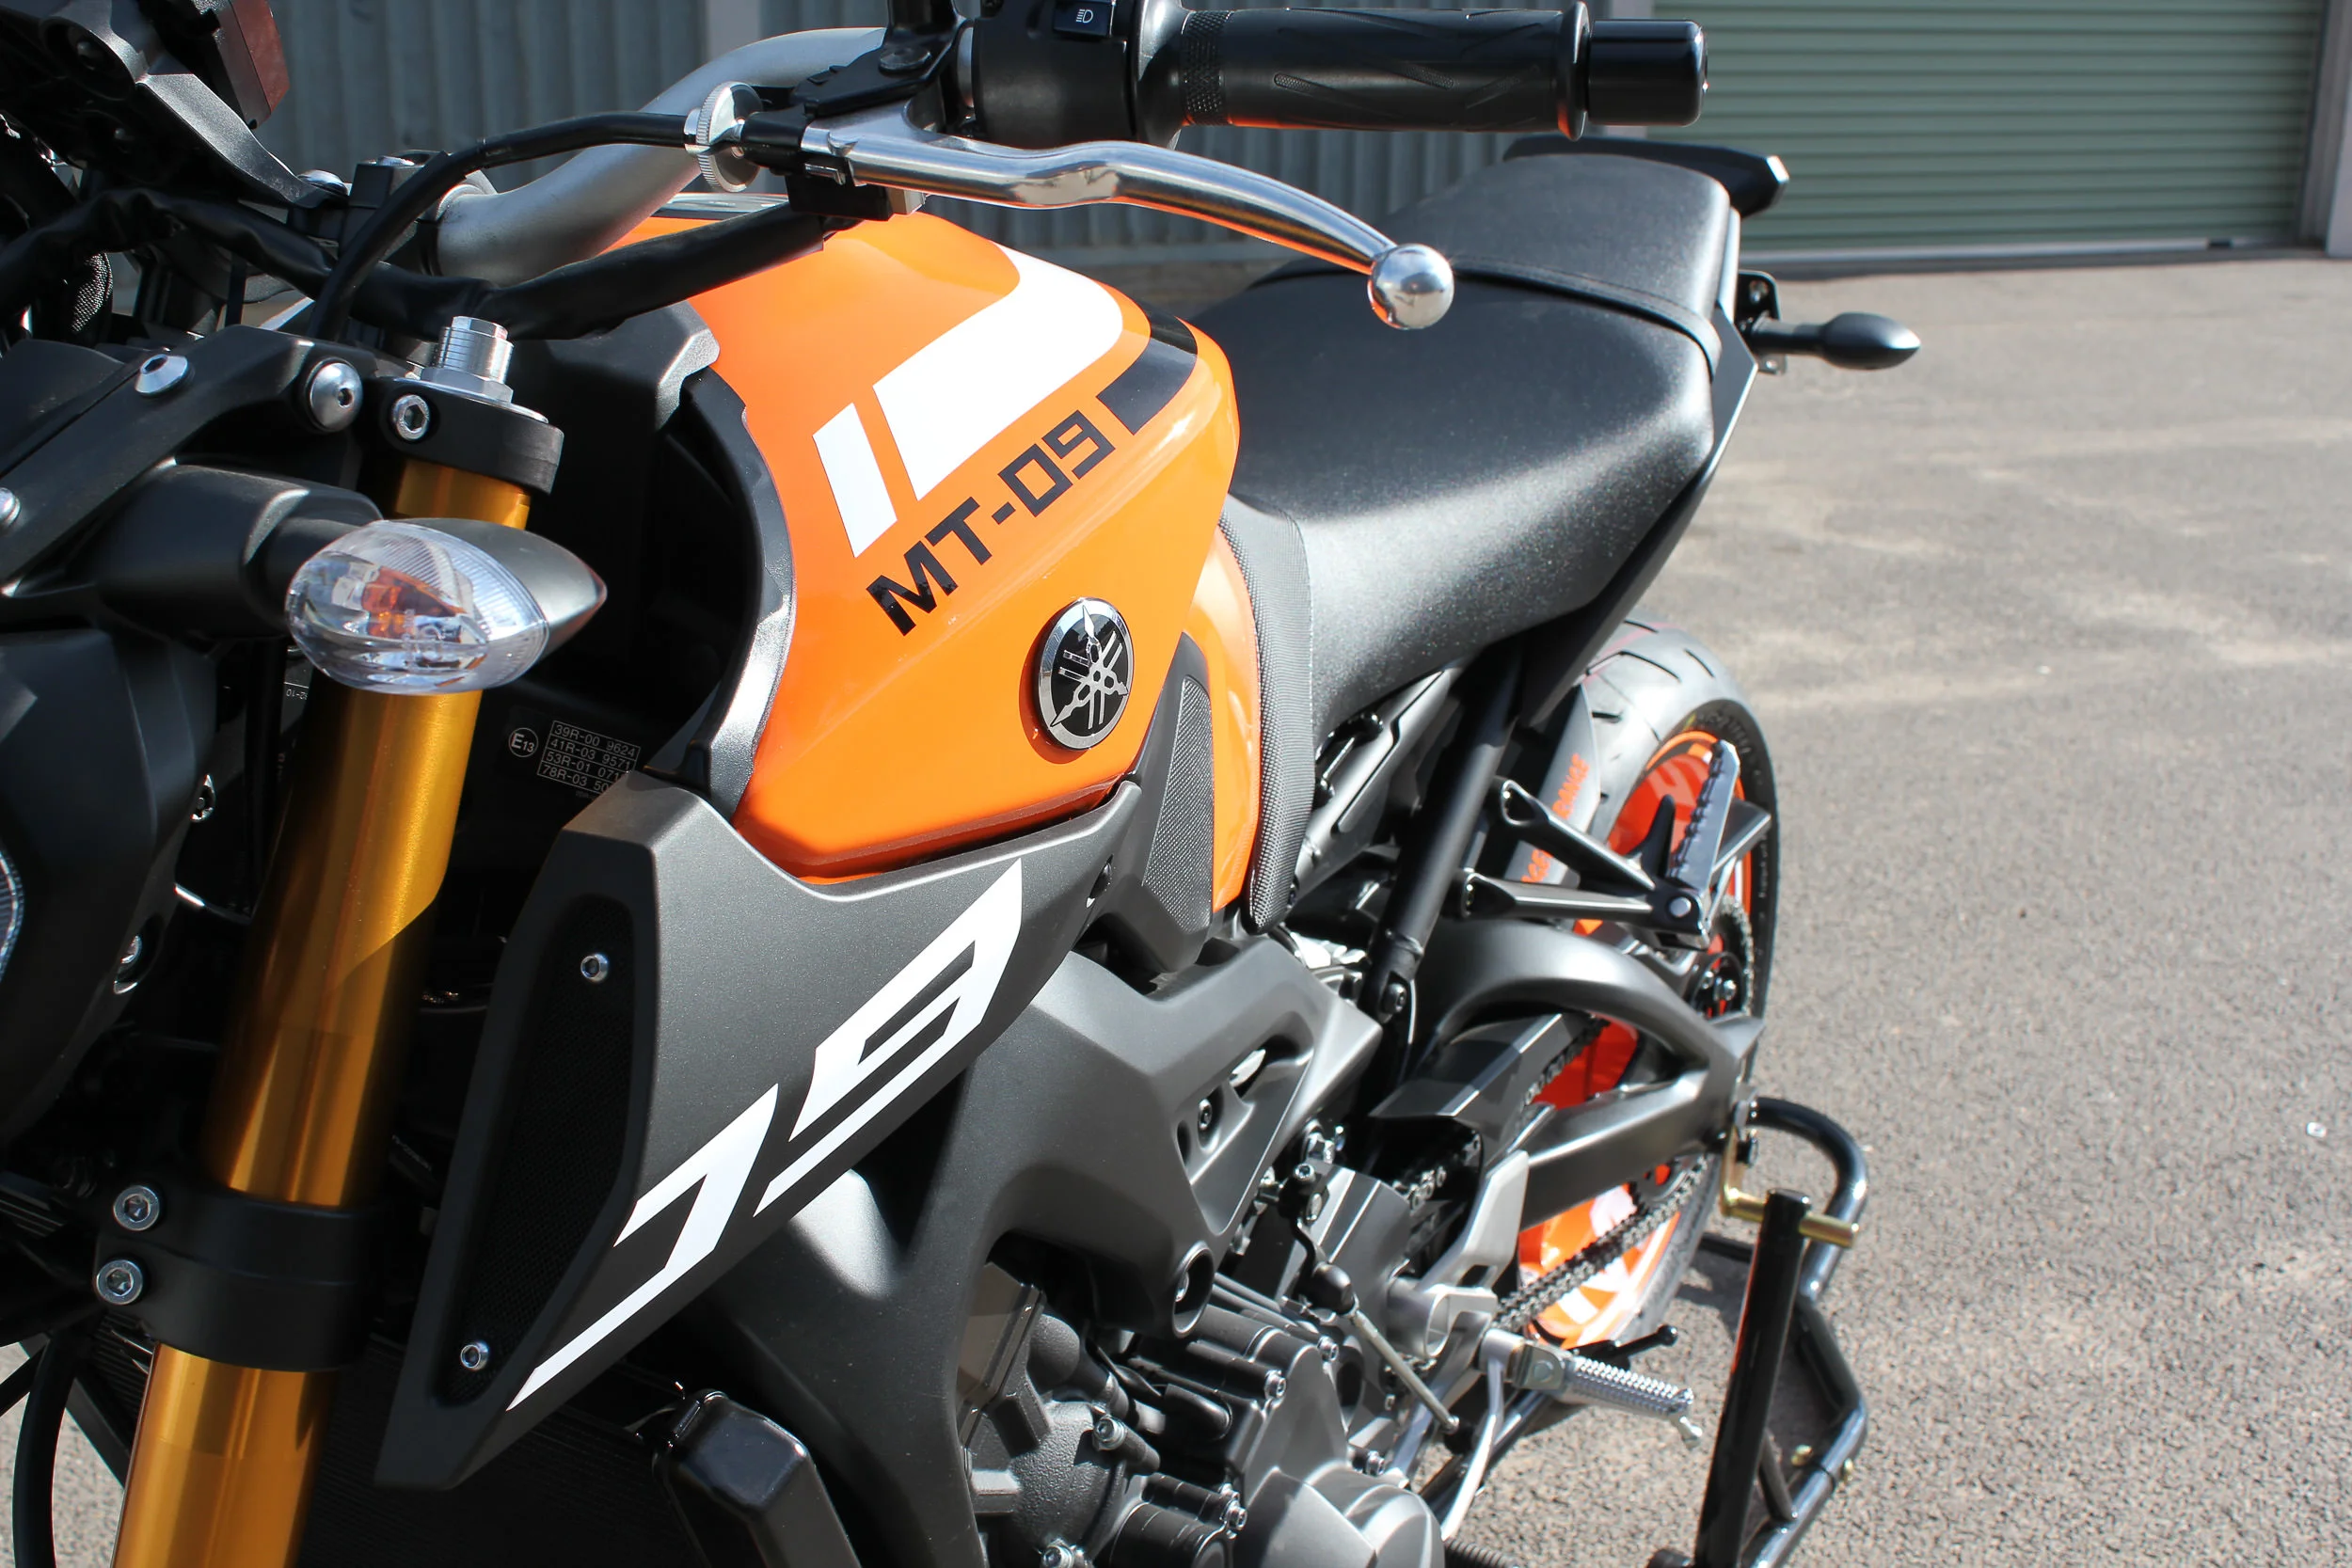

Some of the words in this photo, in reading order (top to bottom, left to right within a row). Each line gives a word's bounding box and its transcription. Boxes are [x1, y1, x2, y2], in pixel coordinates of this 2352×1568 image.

[866, 409, 1117, 637] MT-09
[550, 738, 596, 760] 41R-03
[602, 753, 631, 770] 9571
[554, 724, 600, 747] 39R-00
[607, 740, 636, 758] 9624
[542, 764, 588, 786] 78R-03
[546, 751, 591, 773] 53R-01
[597, 767, 620, 782] 071
